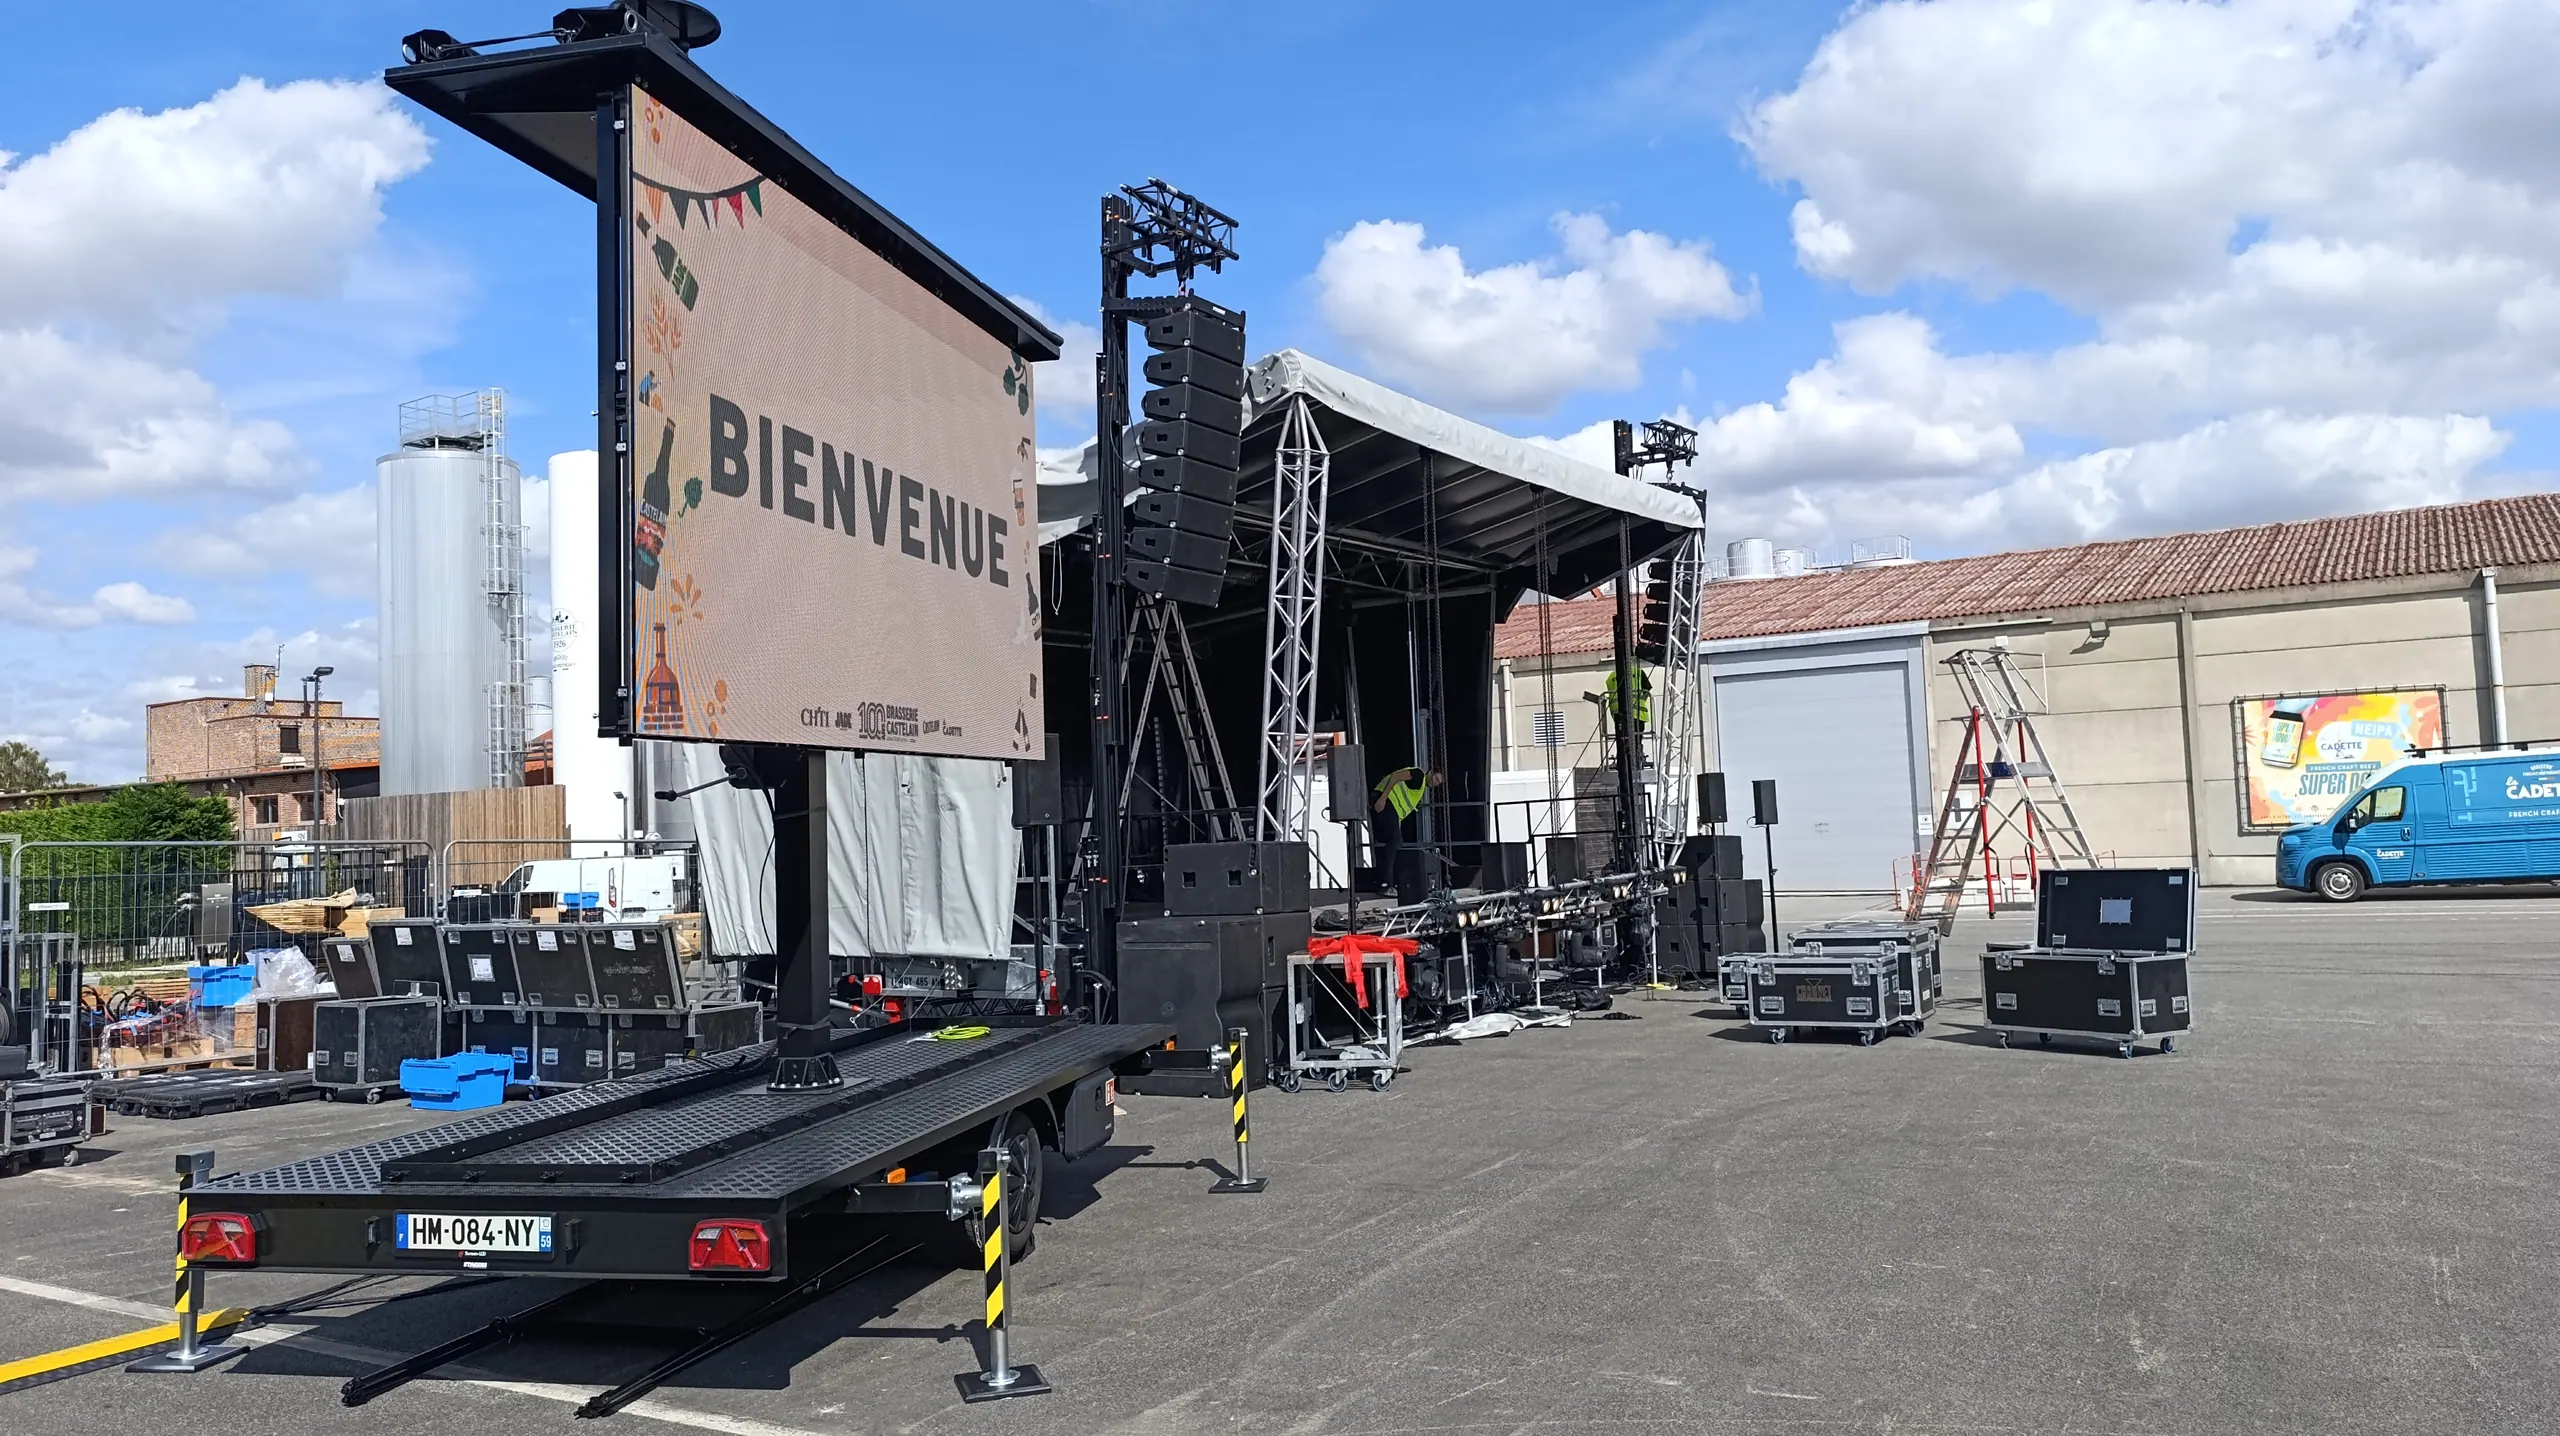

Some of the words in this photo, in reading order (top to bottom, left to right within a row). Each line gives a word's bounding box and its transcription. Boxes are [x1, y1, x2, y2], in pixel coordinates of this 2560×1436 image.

[709, 392, 1010, 589] BIENVENUE
[886, 704, 919, 723] BRASSERIE
[886, 720, 919, 738] CASTELAIN
[2354, 722, 2394, 738] NEIPA
[2320, 740, 2363, 751] CADETTE
[2337, 763, 2358, 771] CRAFT
[2299, 773, 2346, 795] SUPER
[398, 1233, 404, 1242] F
[412, 1217, 535, 1247] HM-084-NY
[540, 1235, 552, 1248] 59
